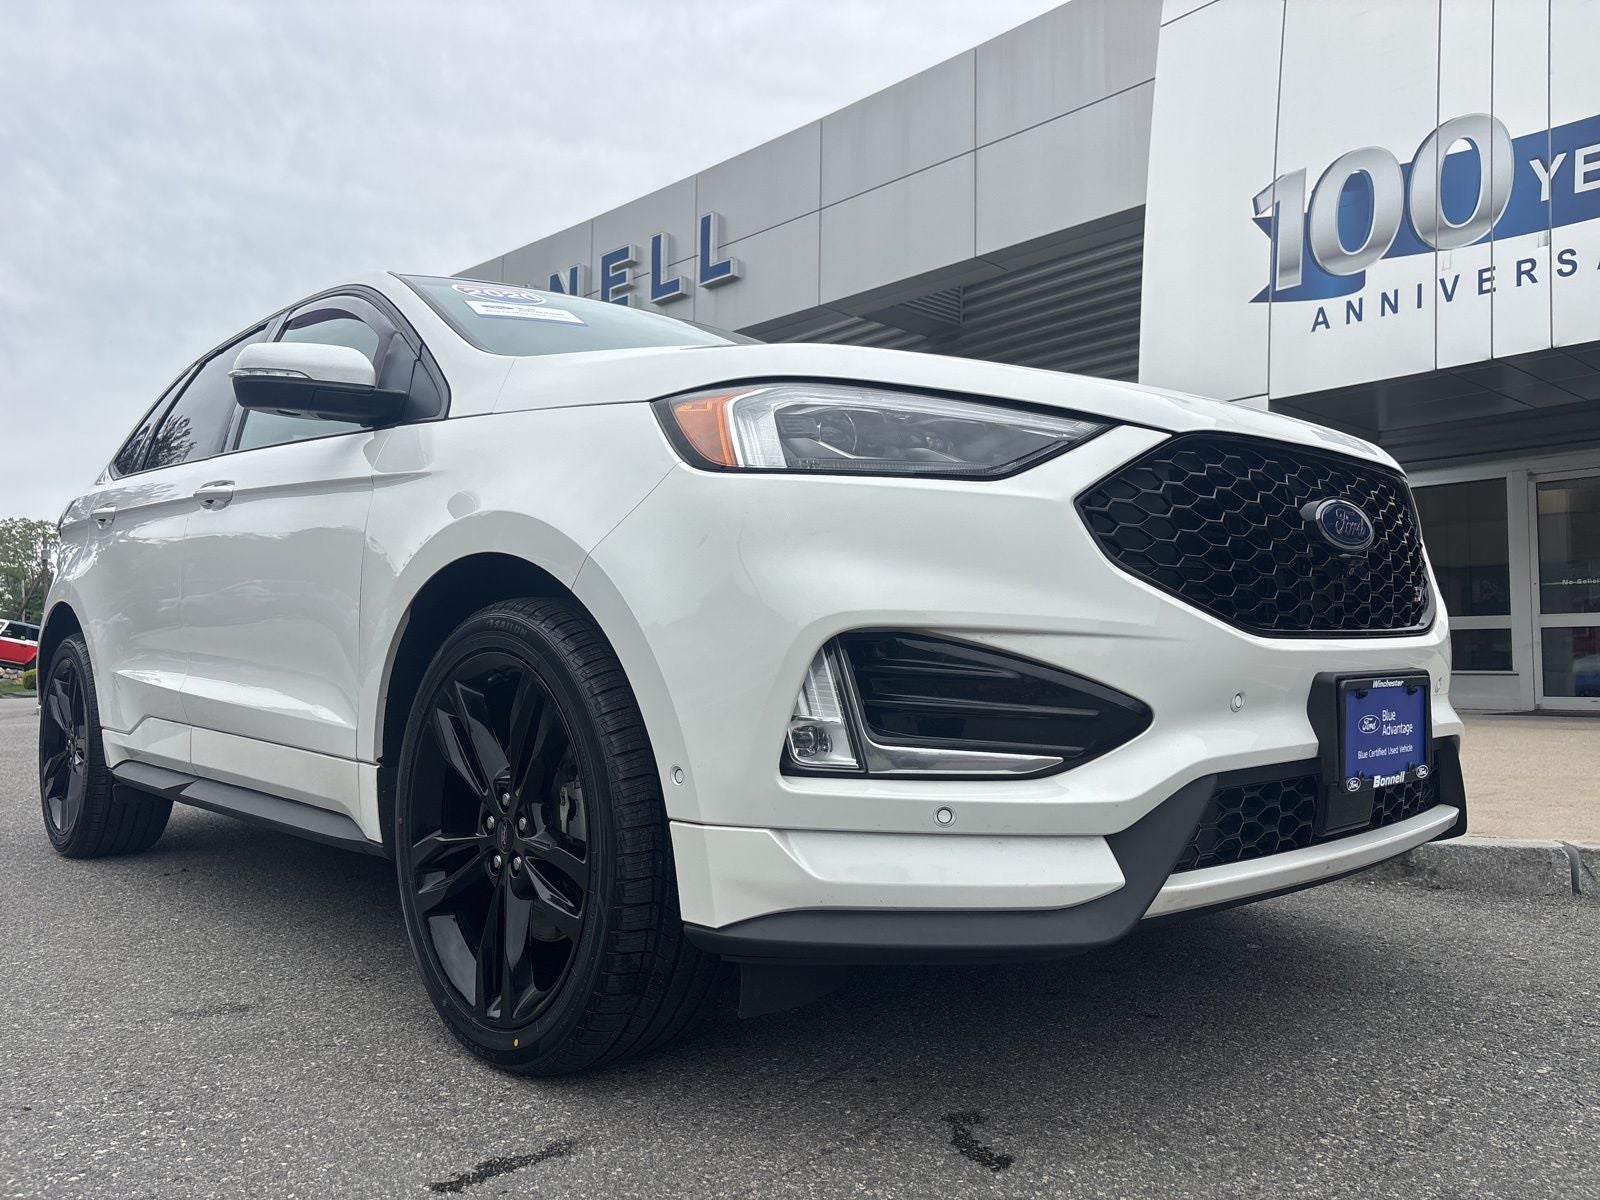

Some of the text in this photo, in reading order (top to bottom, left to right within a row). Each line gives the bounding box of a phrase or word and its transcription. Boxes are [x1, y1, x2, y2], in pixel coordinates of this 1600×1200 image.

[1251, 112, 1515, 291] 100
[463, 287, 541, 301] 2020
[1311, 248, 1600, 332] ANNIVERS
[1335, 507, 1367, 538] Ford
[1372, 680, 1404, 688] Winchester
[1382, 709, 1396, 722] Blue
[1382, 723, 1413, 736] Advantage
[1357, 743, 1413, 760] Blue Certified Used Vehicle
[1372, 771, 1405, 788] Bonnell
